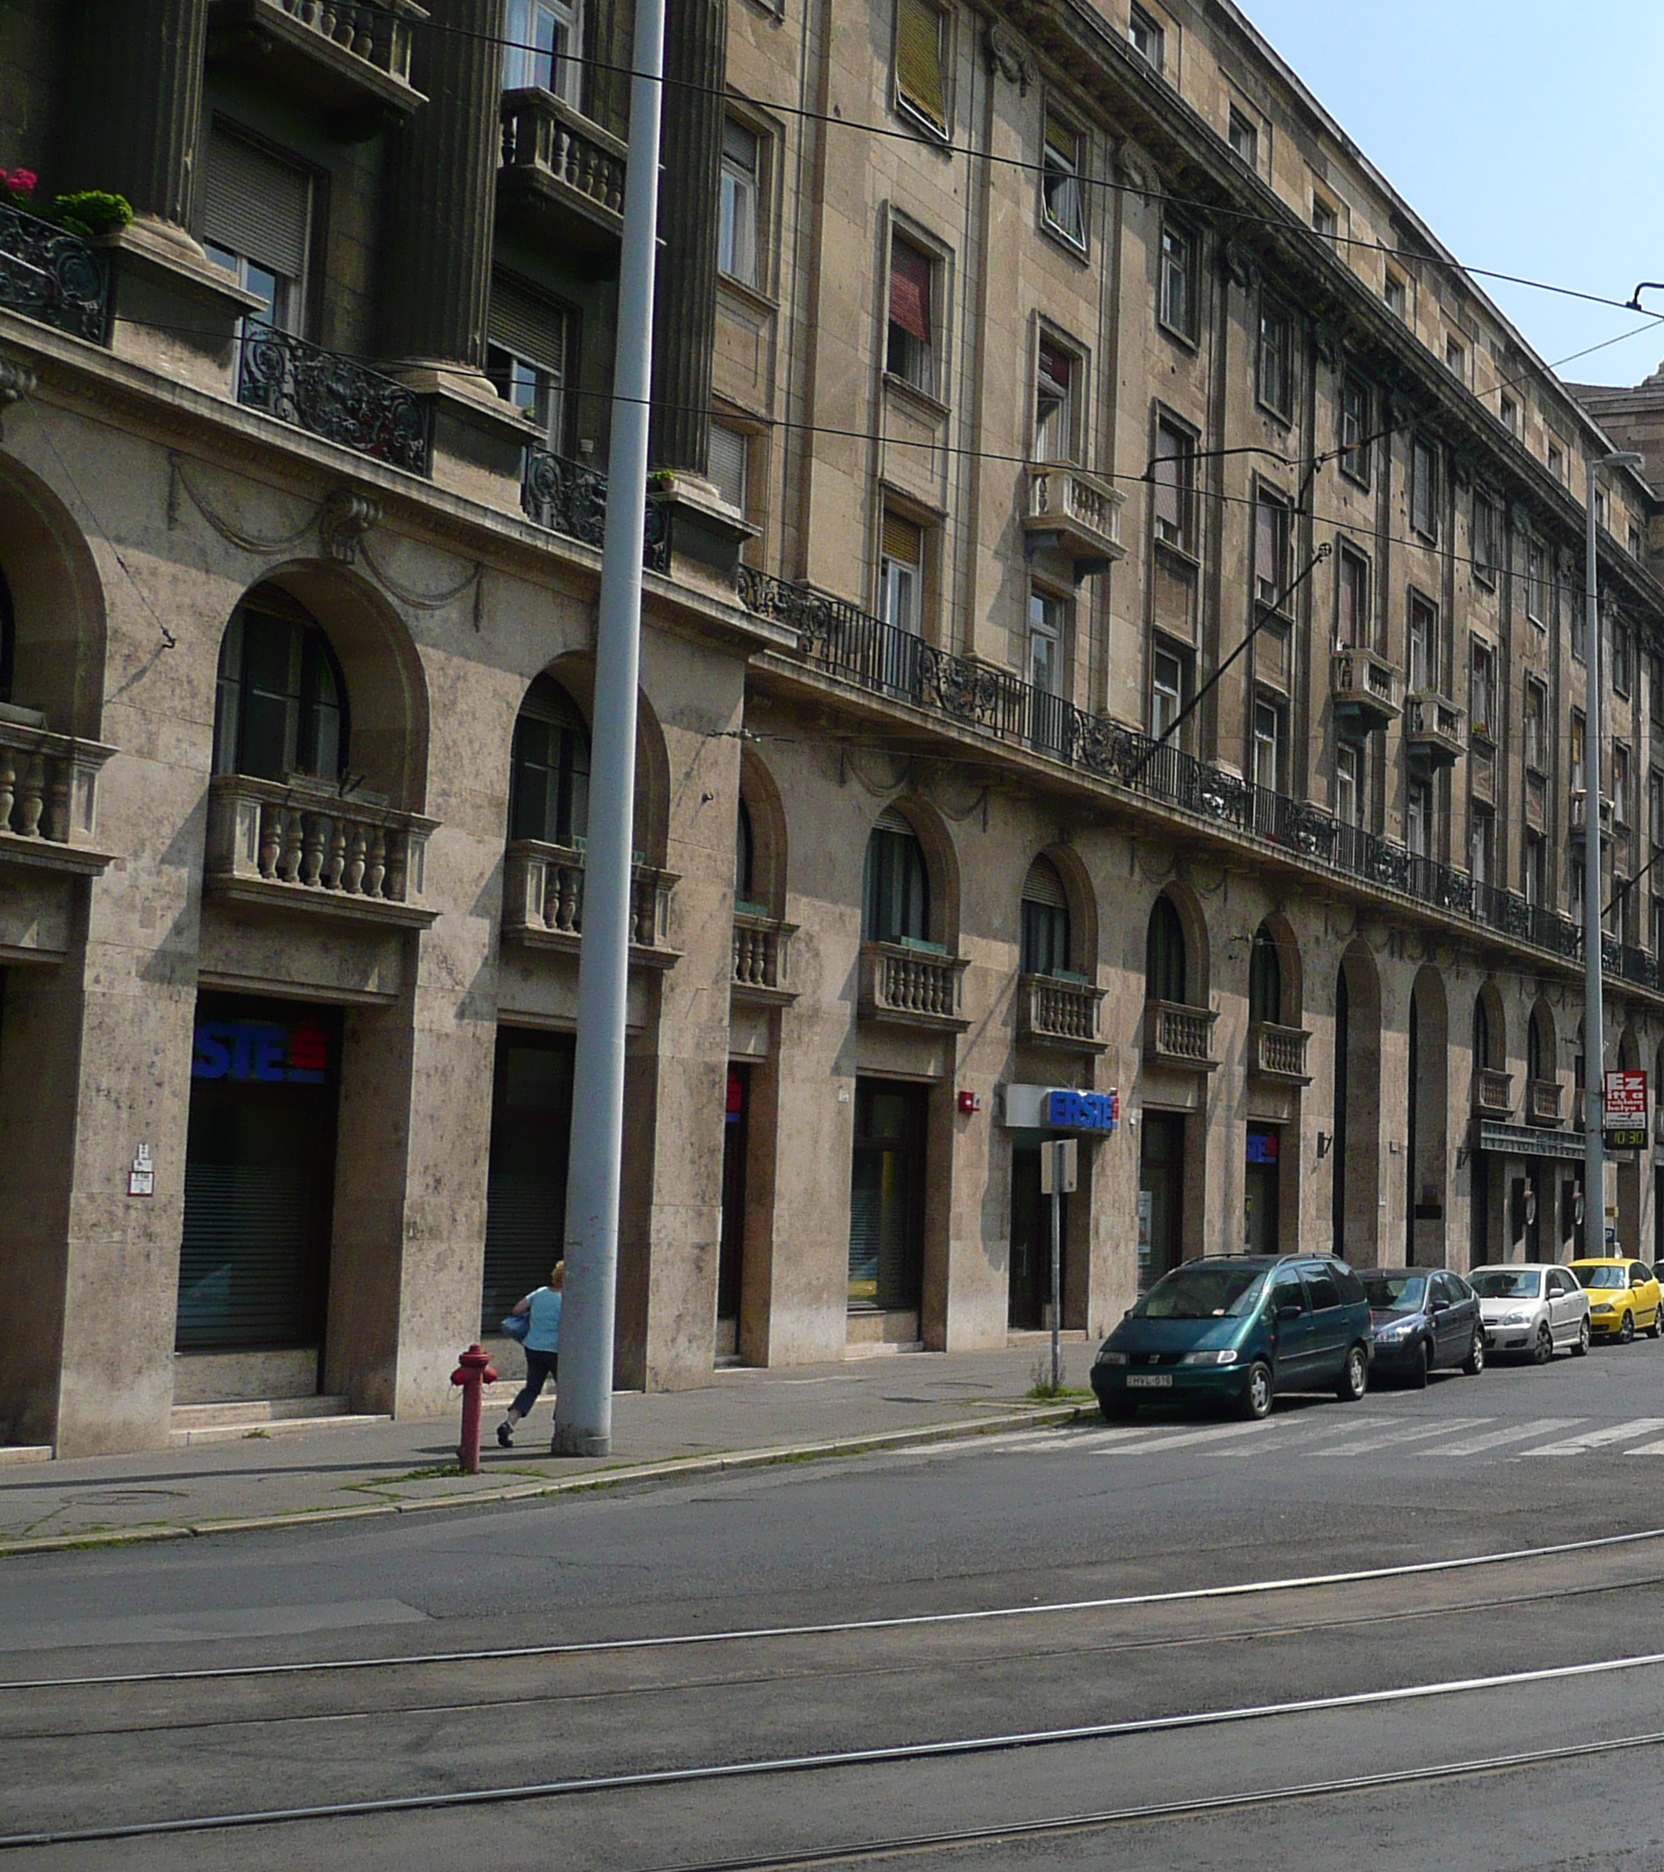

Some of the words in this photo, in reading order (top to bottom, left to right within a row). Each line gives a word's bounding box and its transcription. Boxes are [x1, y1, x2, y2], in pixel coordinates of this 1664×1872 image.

[1607, 1073, 1643, 1090] Ez
[1607, 1090, 1627, 1100] itt
[1050, 1091, 1113, 1130] ERSTE
[1614, 1130, 1644, 1144] 10:30
